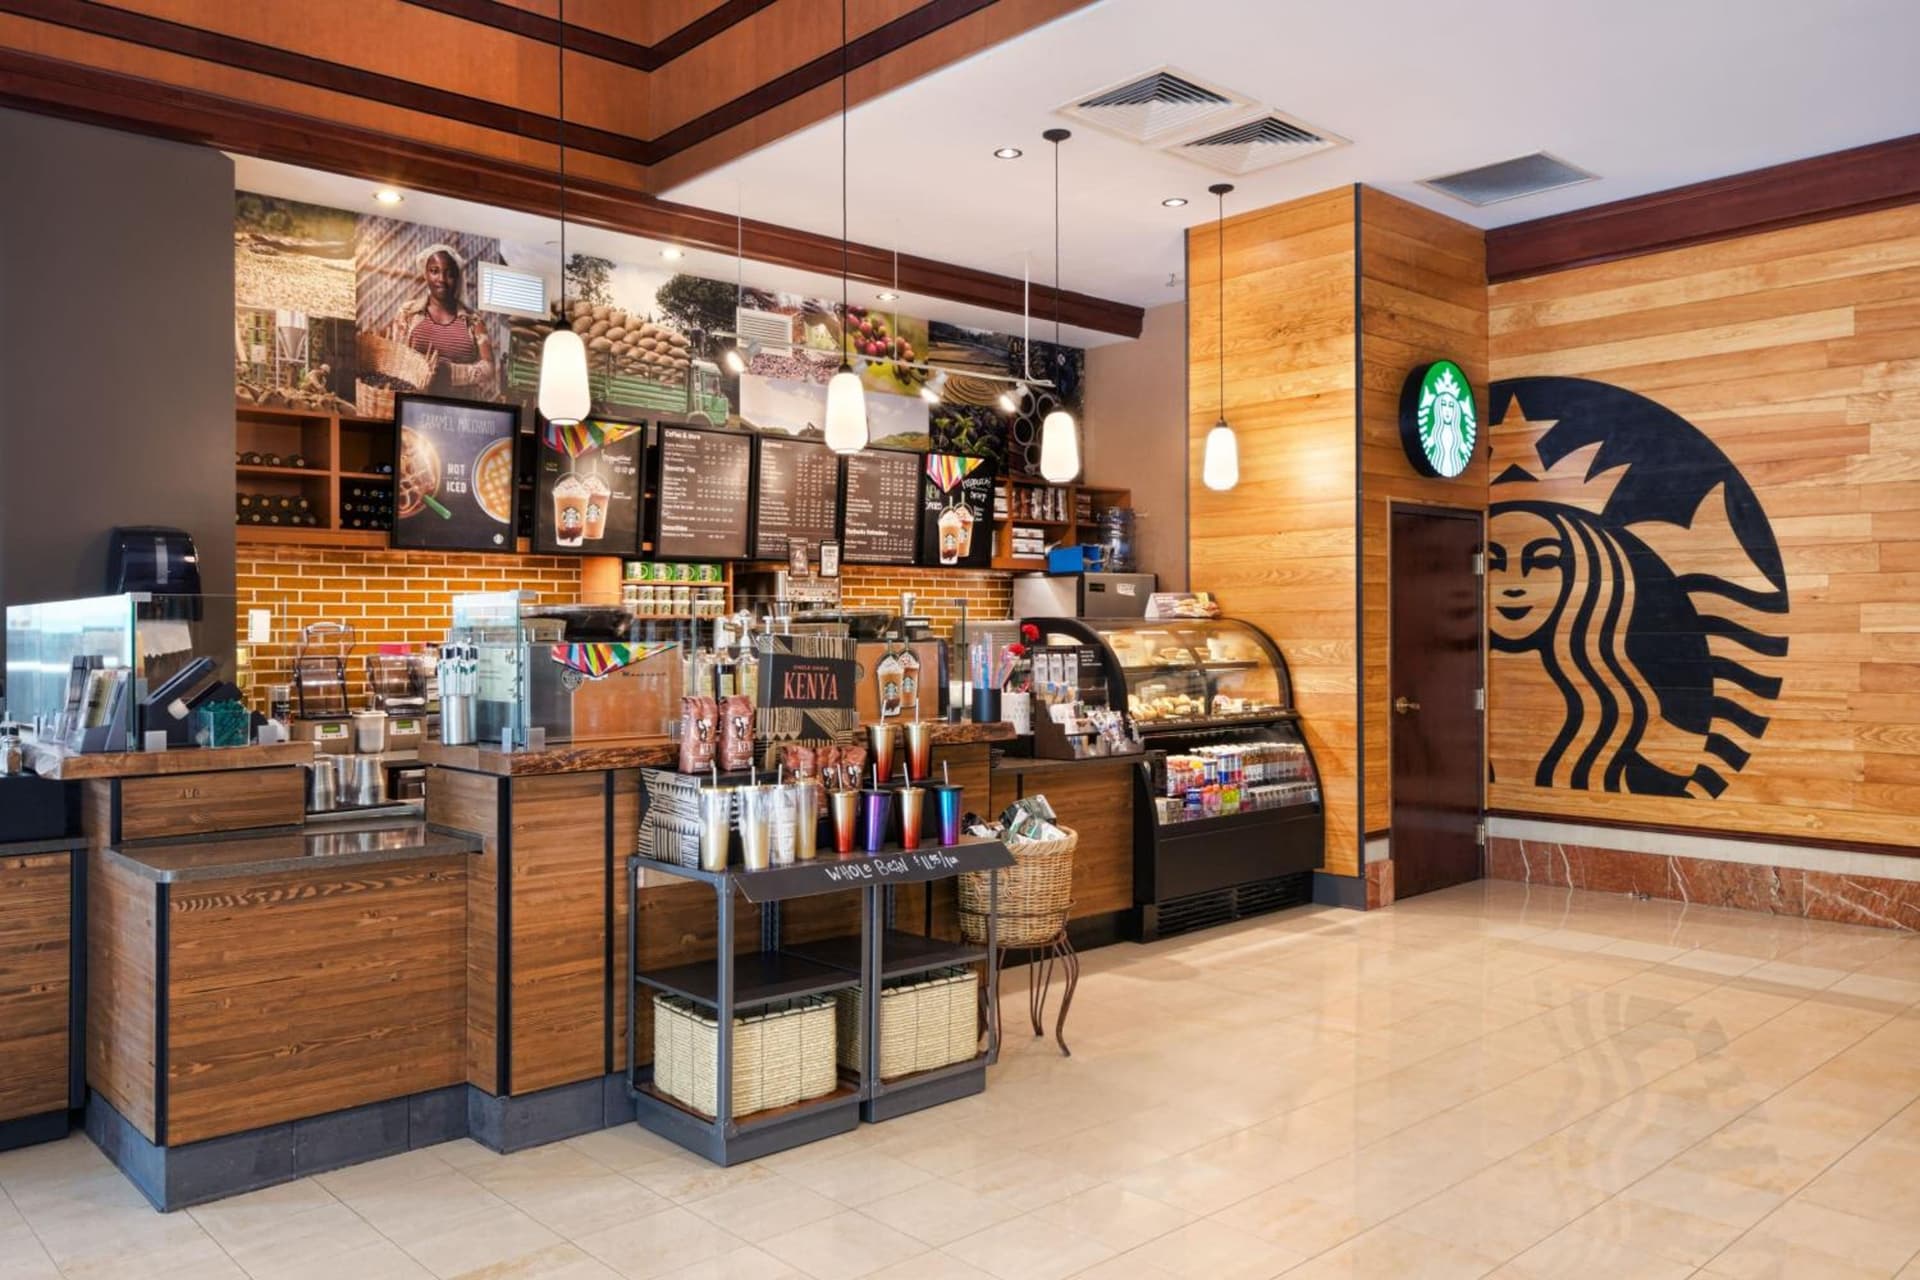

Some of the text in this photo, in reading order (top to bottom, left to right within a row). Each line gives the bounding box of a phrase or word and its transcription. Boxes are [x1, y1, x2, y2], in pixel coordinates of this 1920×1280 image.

[420, 412, 454, 432] CARAMEL
[447, 463, 465, 476] HOT
[446, 480, 467, 493] ICED
[784, 671, 838, 700] KENYA
